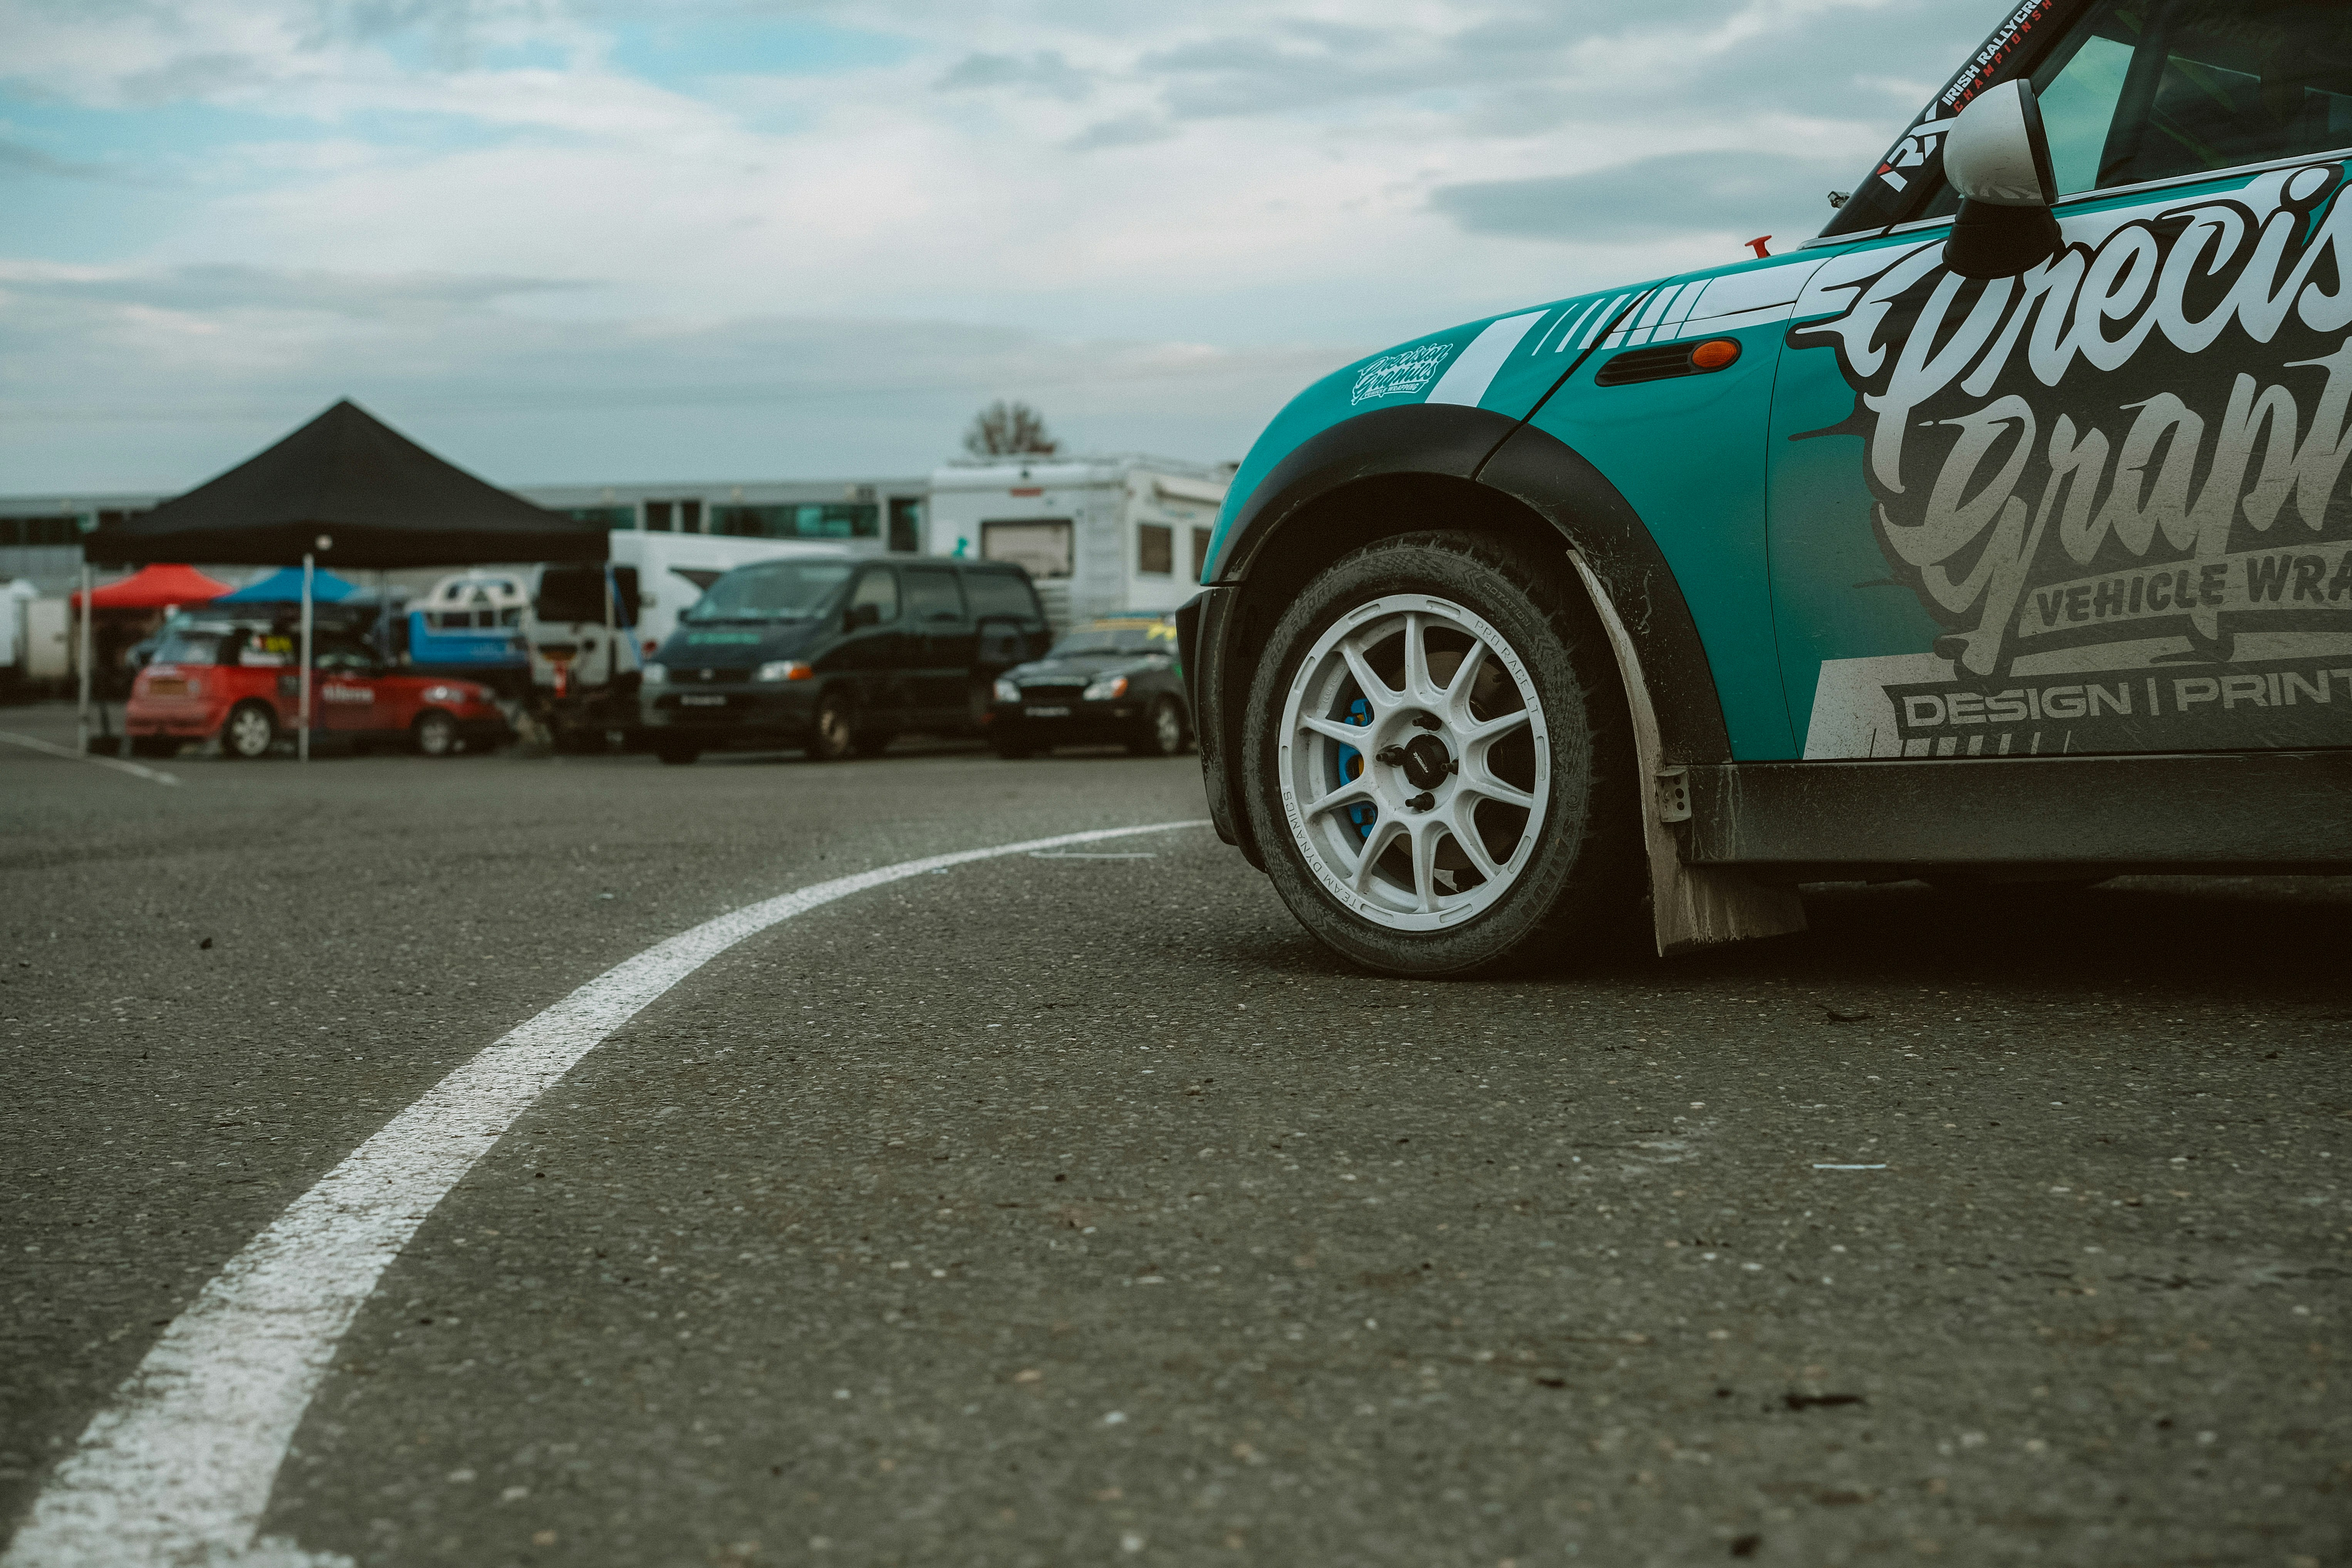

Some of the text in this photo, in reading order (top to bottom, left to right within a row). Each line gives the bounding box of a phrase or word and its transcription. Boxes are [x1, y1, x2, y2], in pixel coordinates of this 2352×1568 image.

[1941, 0, 2042, 106] IRISH RALLYCR
[1953, 0, 2052, 112] CHAMPIONSH
[1388, 383, 1420, 392] WRAPPING
[1288, 579, 1337, 632] SPORT
[1483, 582, 1532, 627] ROTATION
[2036, 563, 2228, 627] VEHICLE
[1474, 620, 1539, 714] PRO RACE LT
[1902, 682, 2133, 727] DESIGN
[1283, 791, 1356, 909] TEAM DYNAMICS
[1520, 817, 1576, 919] SAILUN
